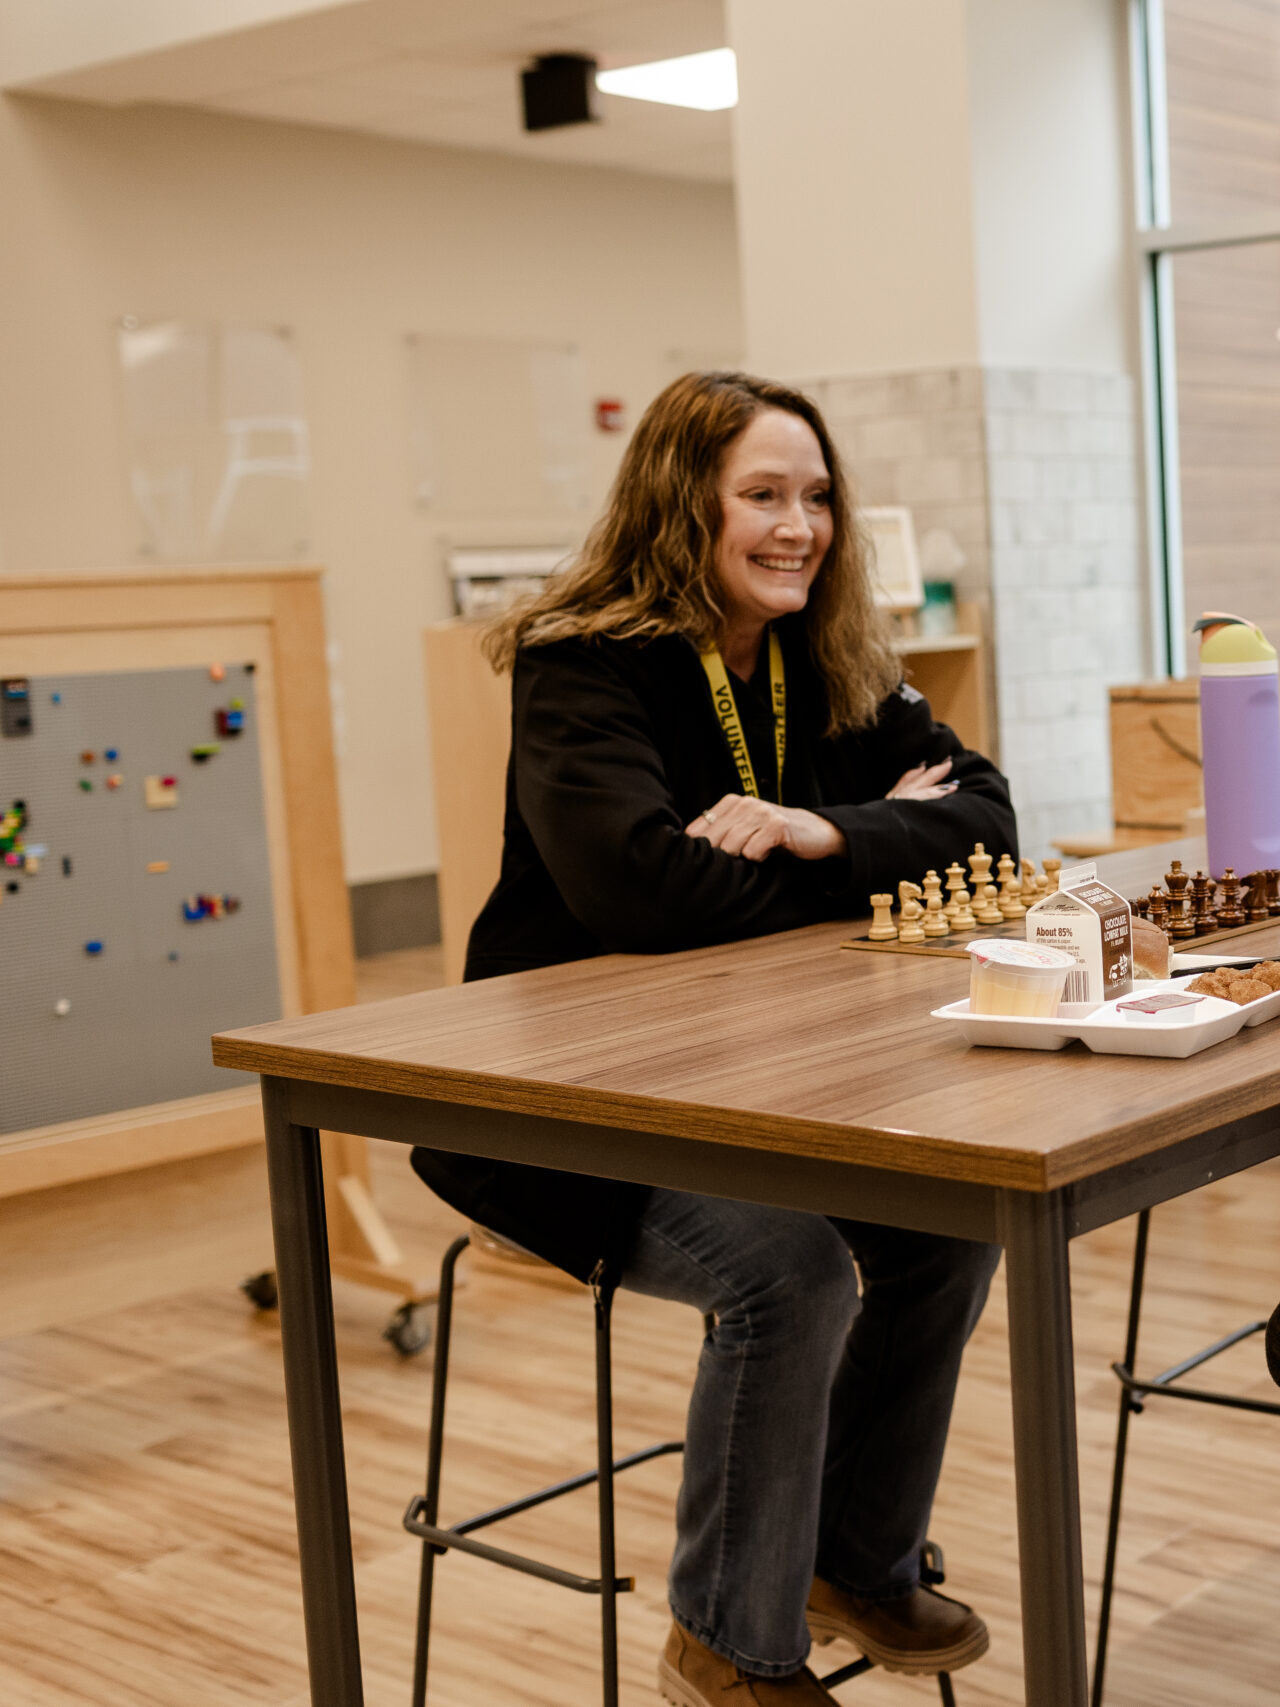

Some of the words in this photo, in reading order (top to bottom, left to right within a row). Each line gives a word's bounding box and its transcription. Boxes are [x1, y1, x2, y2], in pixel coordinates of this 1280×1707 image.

[1104, 914, 1127, 930] CHOCOLATE
[1036, 926, 1057, 937] About
[1058, 927, 1073, 937] 85%
